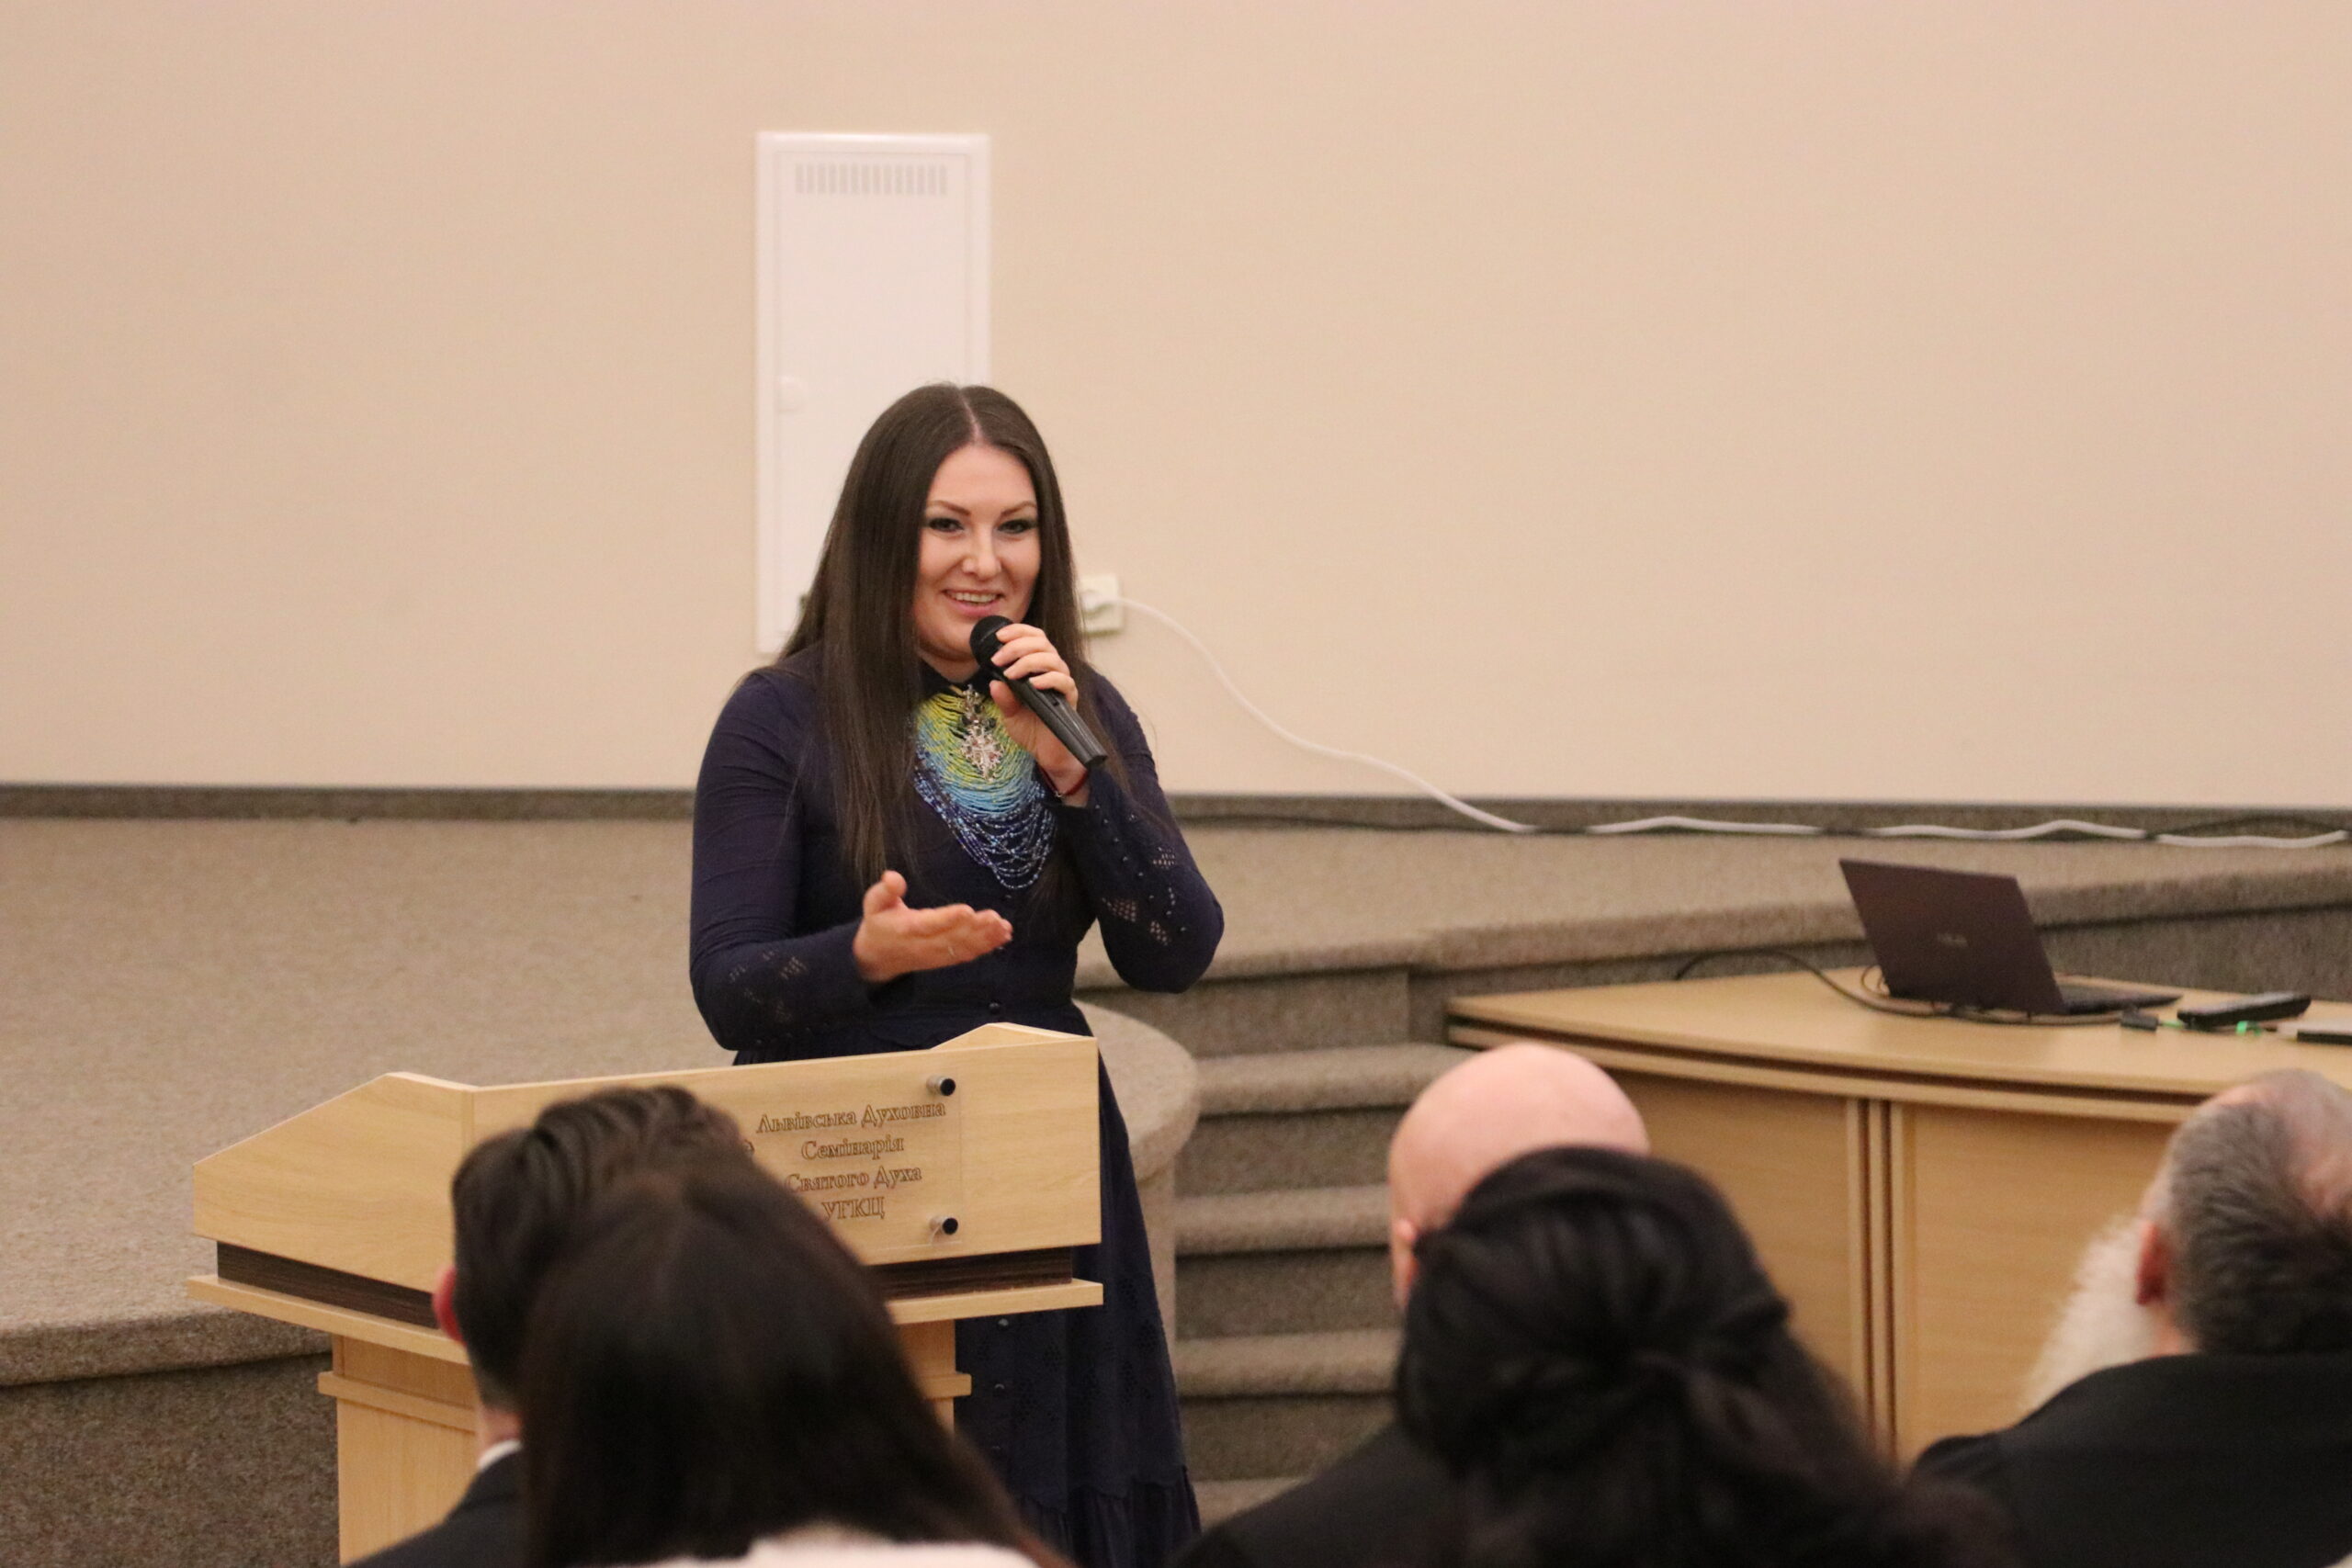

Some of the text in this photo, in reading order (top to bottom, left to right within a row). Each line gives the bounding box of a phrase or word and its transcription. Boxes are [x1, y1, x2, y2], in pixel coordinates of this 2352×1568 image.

[757, 1103, 945, 1133] Львівська Духовна
[801, 1134, 904, 1159] Семінарія
[786, 1166, 922, 1191] Святого Духа
[821, 1197, 885, 1220] УГКЦ
